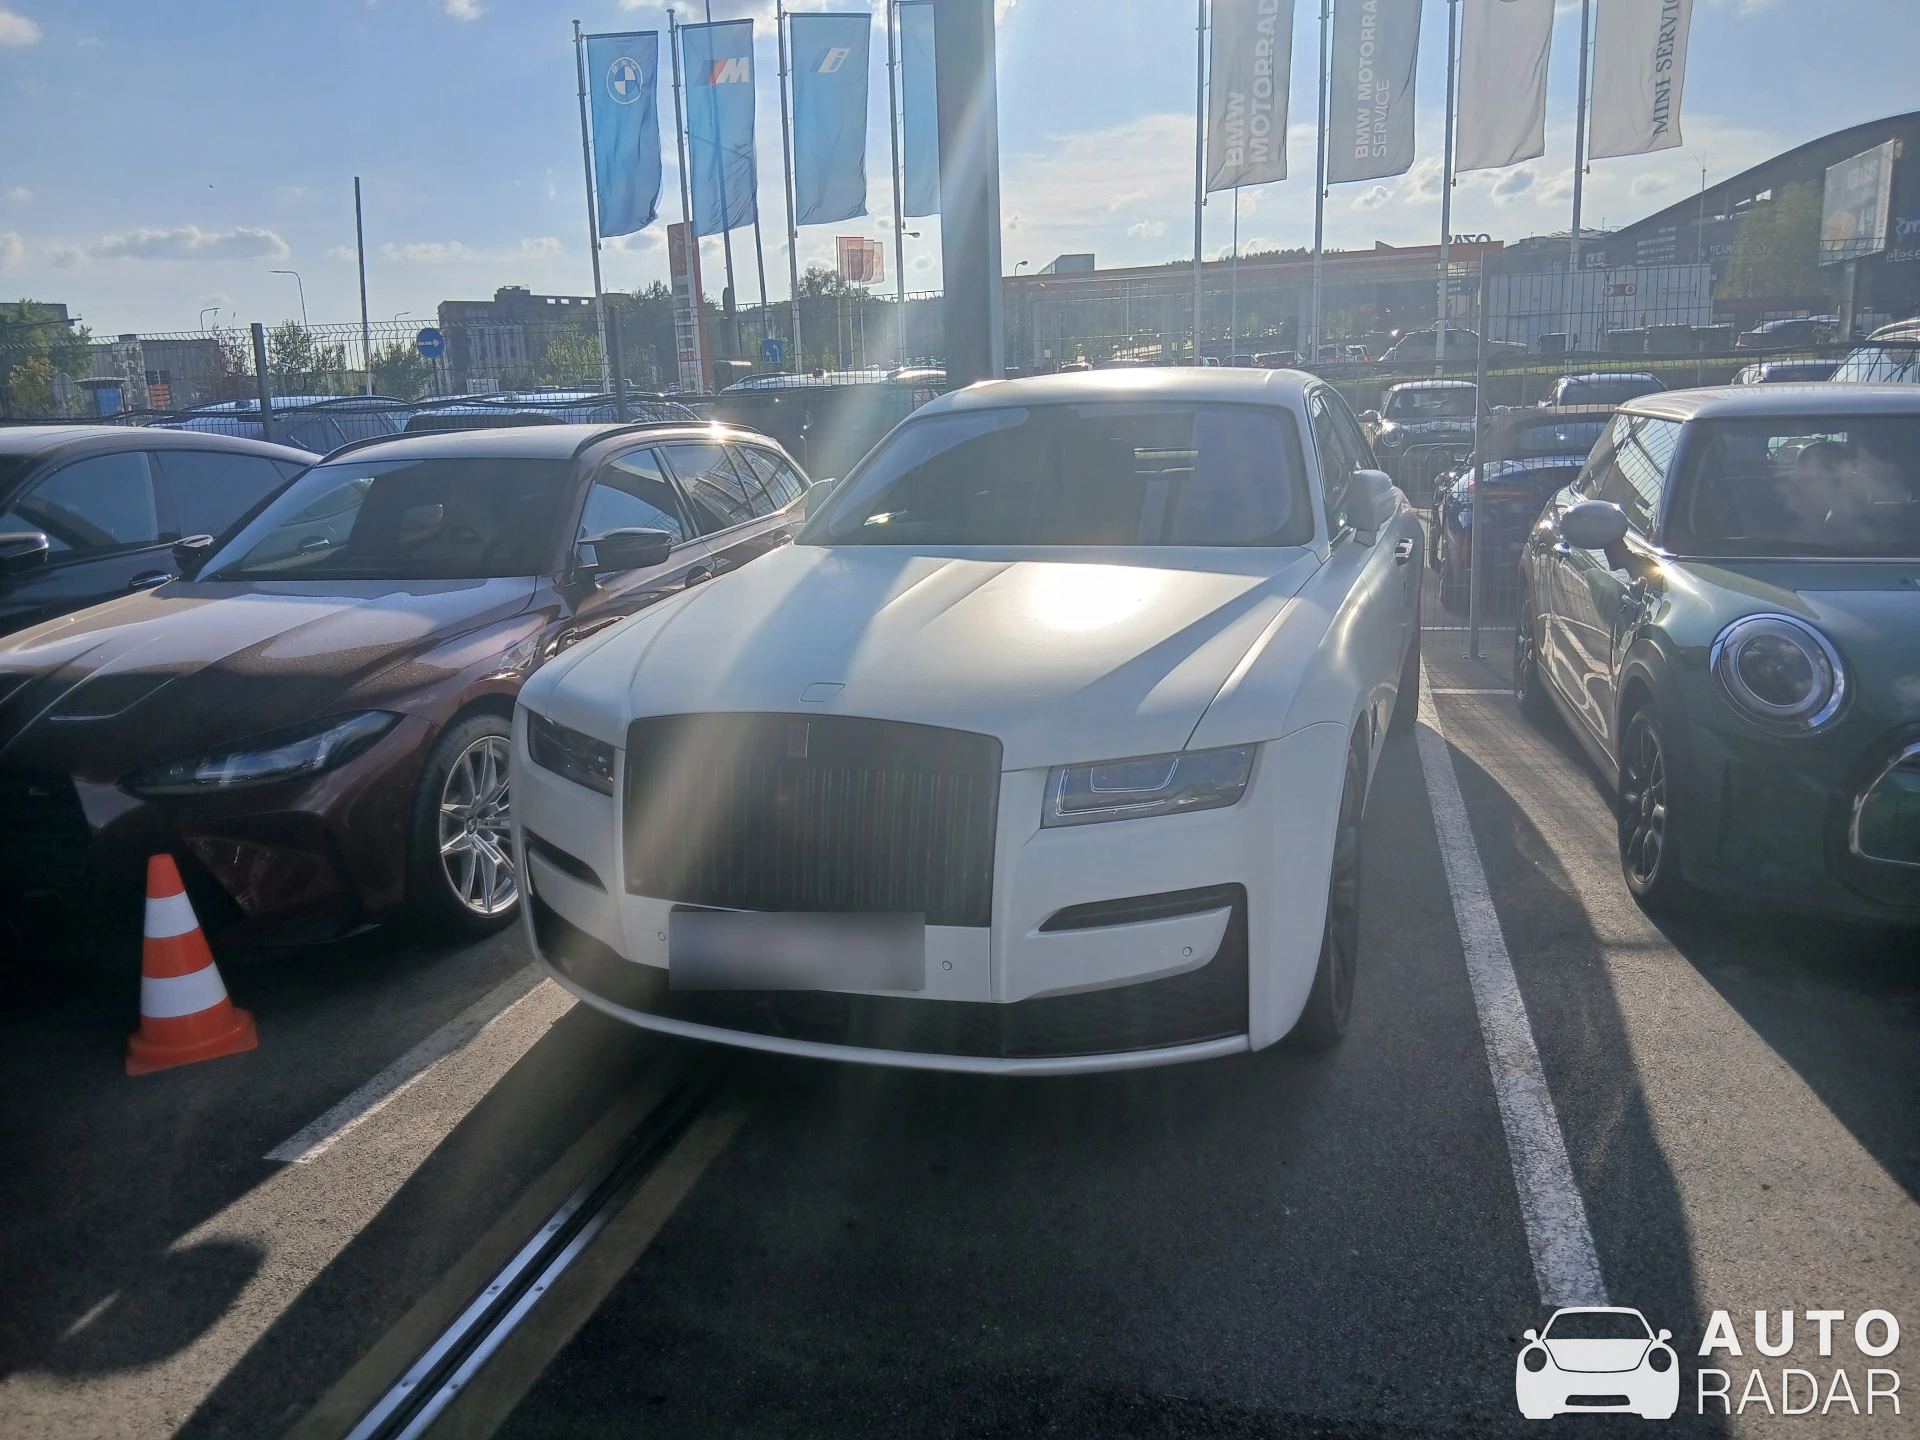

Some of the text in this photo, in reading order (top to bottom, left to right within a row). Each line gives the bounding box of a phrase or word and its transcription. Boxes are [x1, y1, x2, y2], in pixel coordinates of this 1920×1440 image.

[611, 59, 638, 74] BMW
[1249, 0, 1279, 164] MOTORRAD
[1225, 91, 1246, 168] BMW
[1354, 108, 1371, 160] BMW
[1372, 79, 1390, 158] SERVICE
[1652, 77, 1671, 137] MINI
